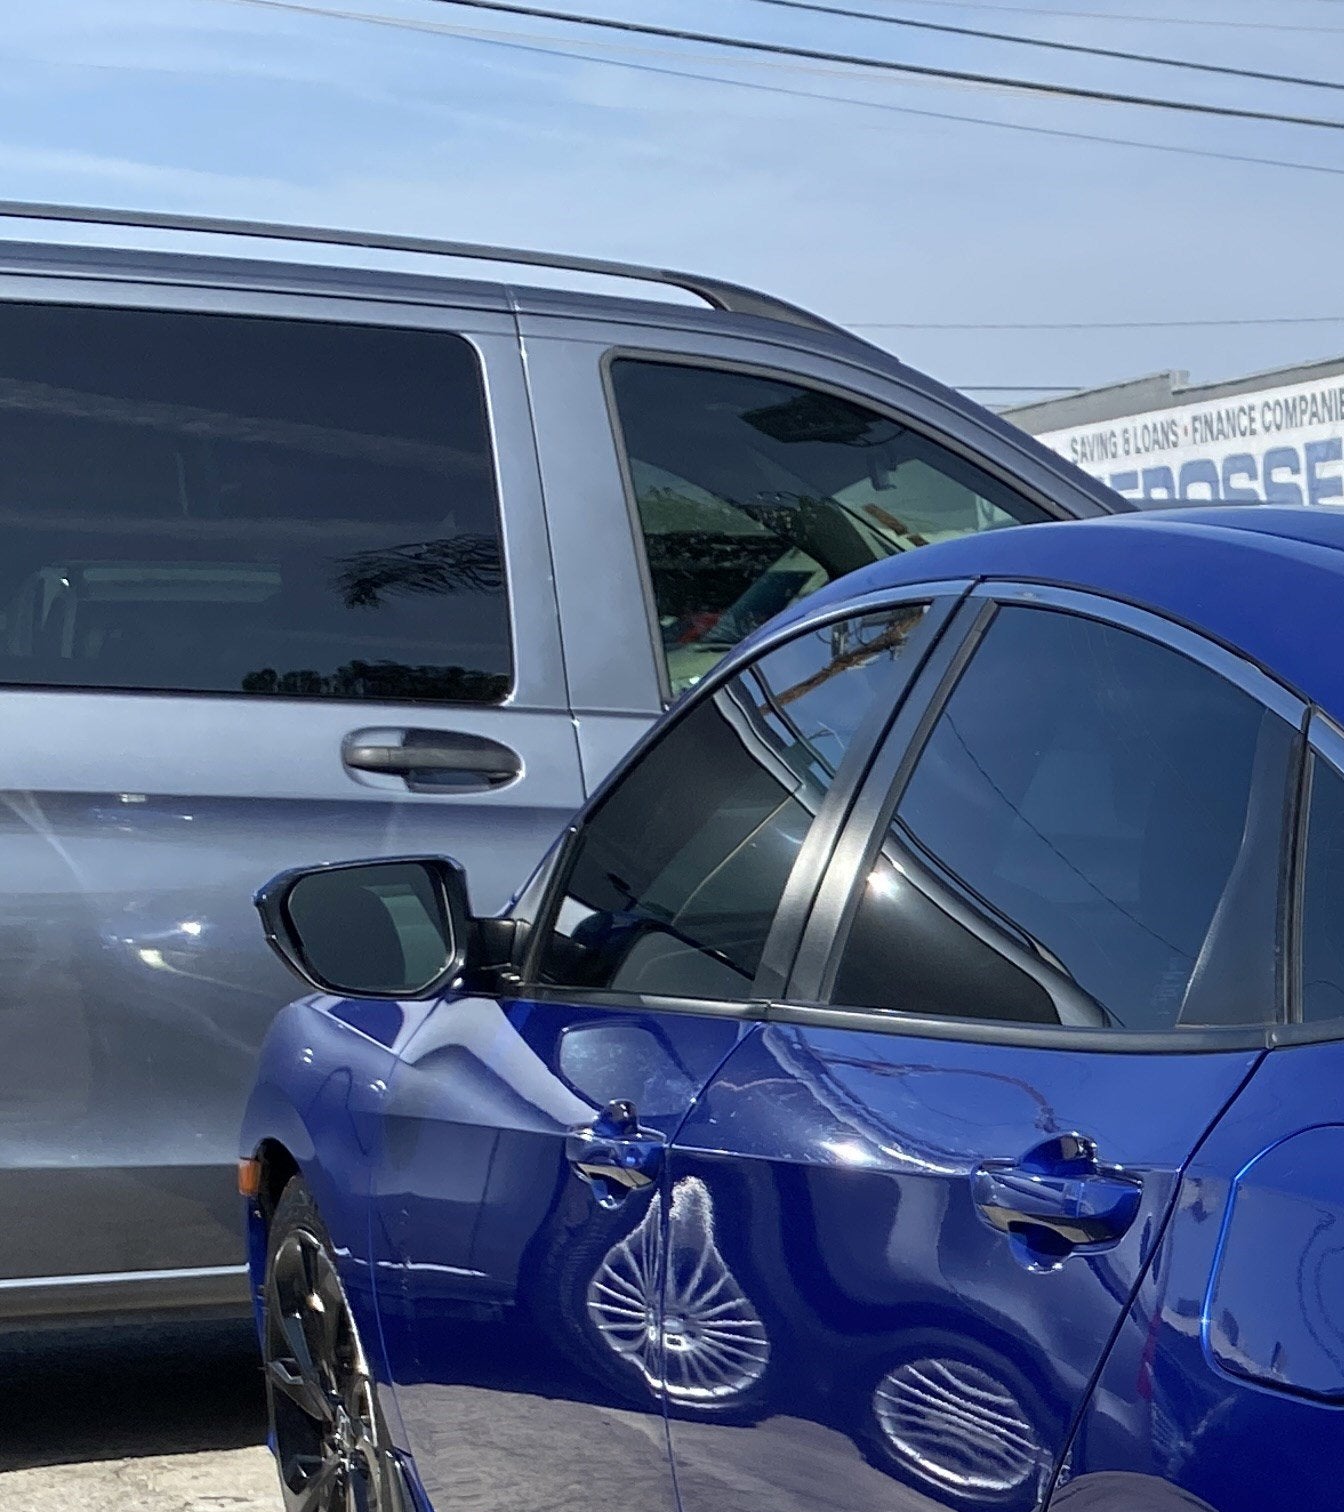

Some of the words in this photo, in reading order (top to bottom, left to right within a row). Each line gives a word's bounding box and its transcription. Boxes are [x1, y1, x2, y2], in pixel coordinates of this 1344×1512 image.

[1070, 429, 1117, 464] SAVING
[1132, 419, 1178, 454] LOANS
[1191, 404, 1257, 445] FINANCE
